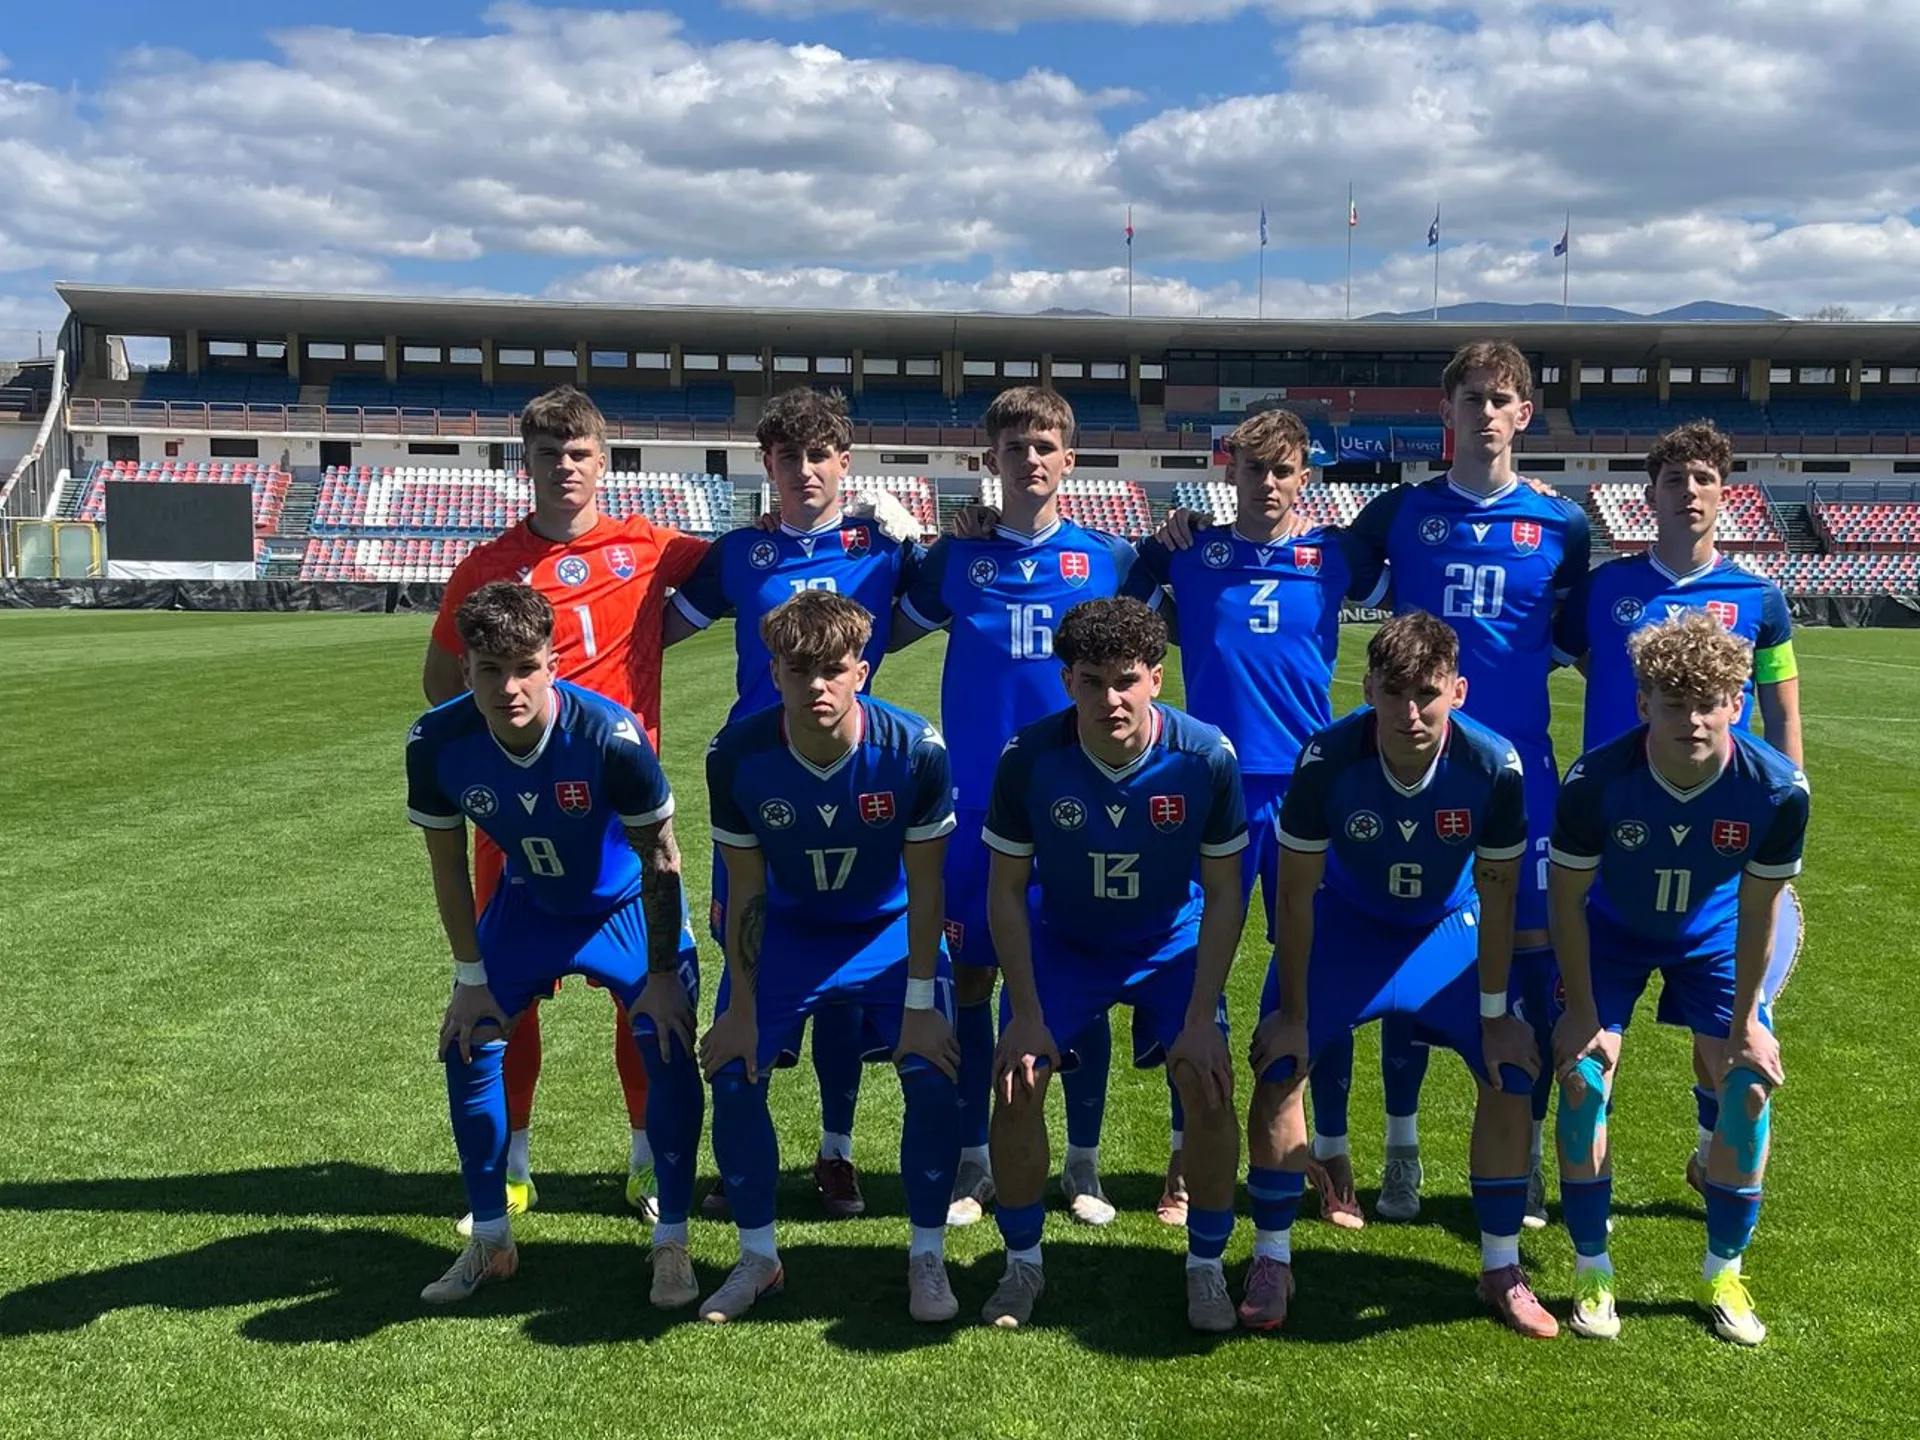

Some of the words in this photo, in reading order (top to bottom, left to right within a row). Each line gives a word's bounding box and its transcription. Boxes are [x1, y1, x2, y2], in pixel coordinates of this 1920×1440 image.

[1249, 579, 1279, 634] 3
[1443, 563, 1506, 618] 20
[573, 603, 597, 659] 1
[1006, 603, 1053, 659] 16
[521, 836, 565, 877] 8
[805, 847, 858, 891] 17
[1088, 852, 1140, 899] 13
[1388, 862, 1423, 898] 6
[1655, 868, 1692, 913] 11
